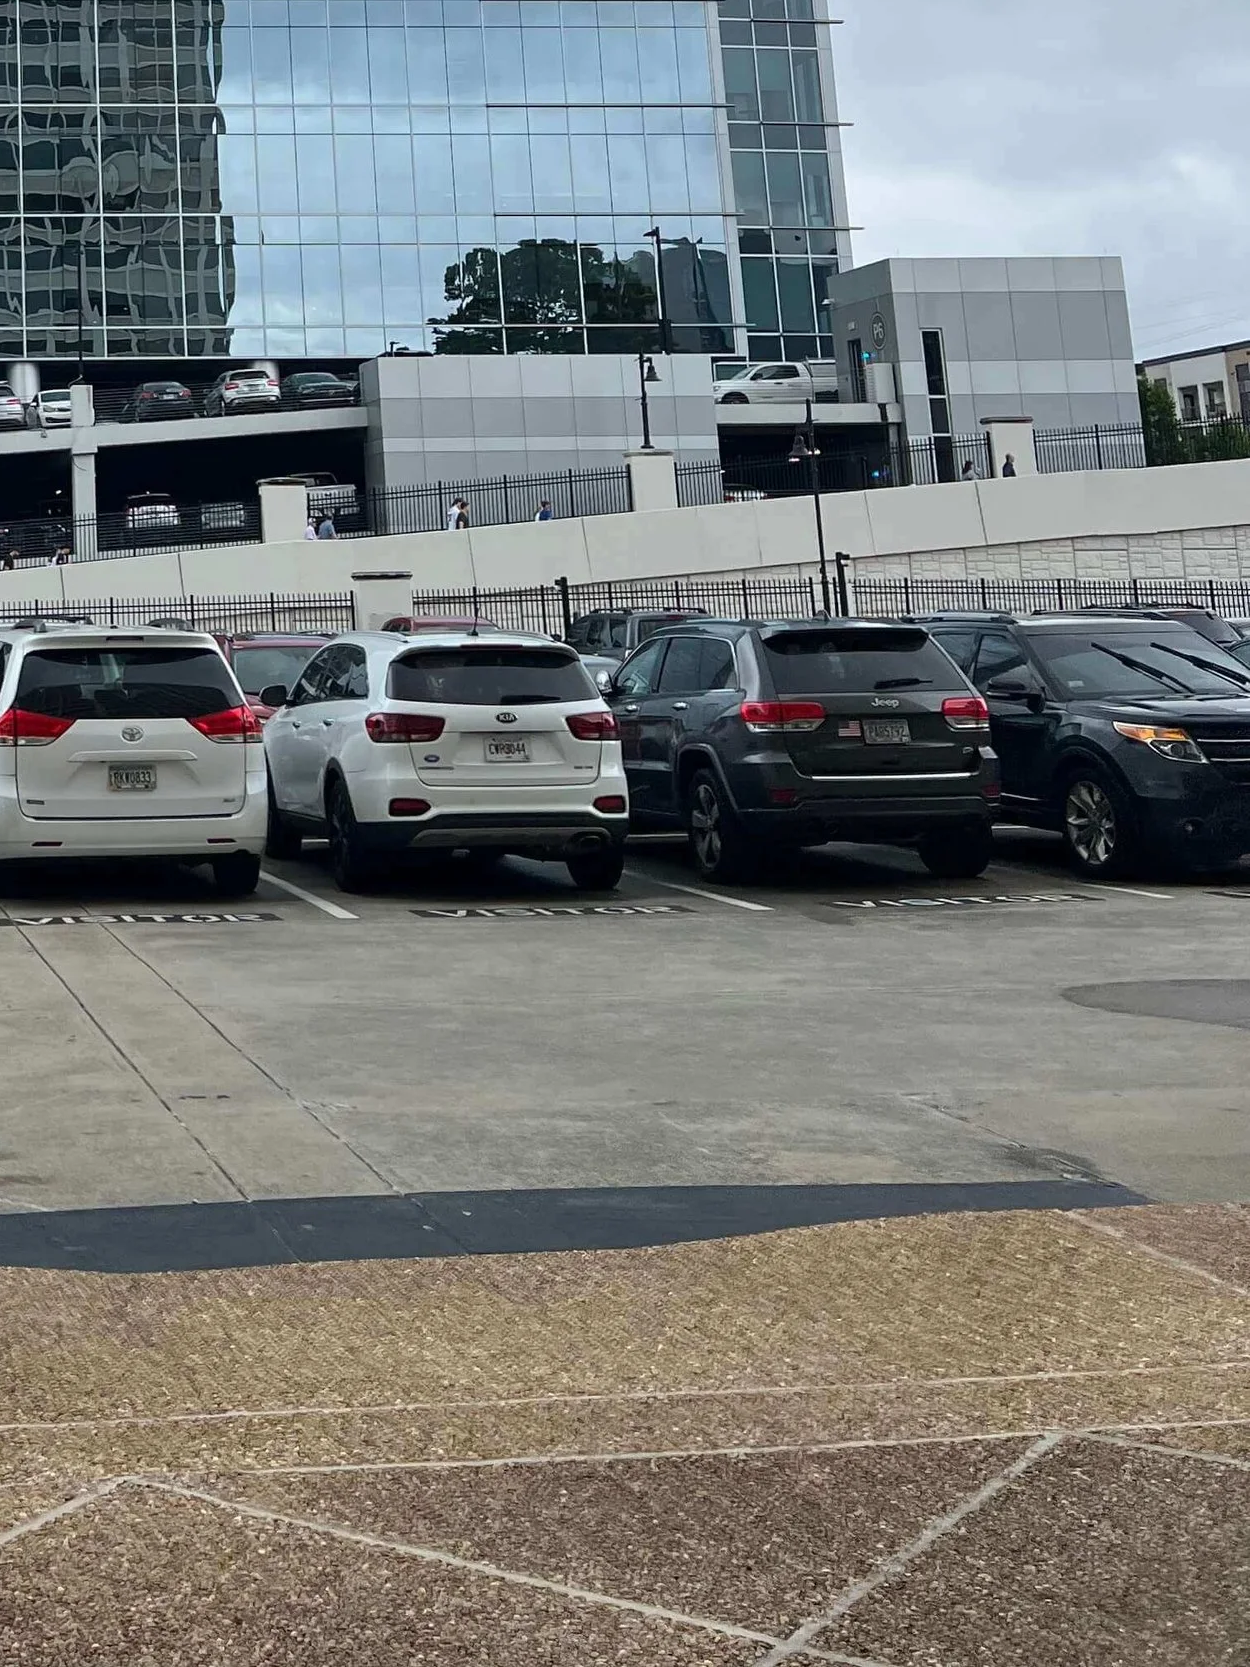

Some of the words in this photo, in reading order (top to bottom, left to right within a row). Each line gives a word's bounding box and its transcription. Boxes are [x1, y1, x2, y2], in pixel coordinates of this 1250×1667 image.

[871, 697, 900, 708] Jeep
[498, 713, 516, 722] KIA
[12, 914, 264, 925] VISITOR
